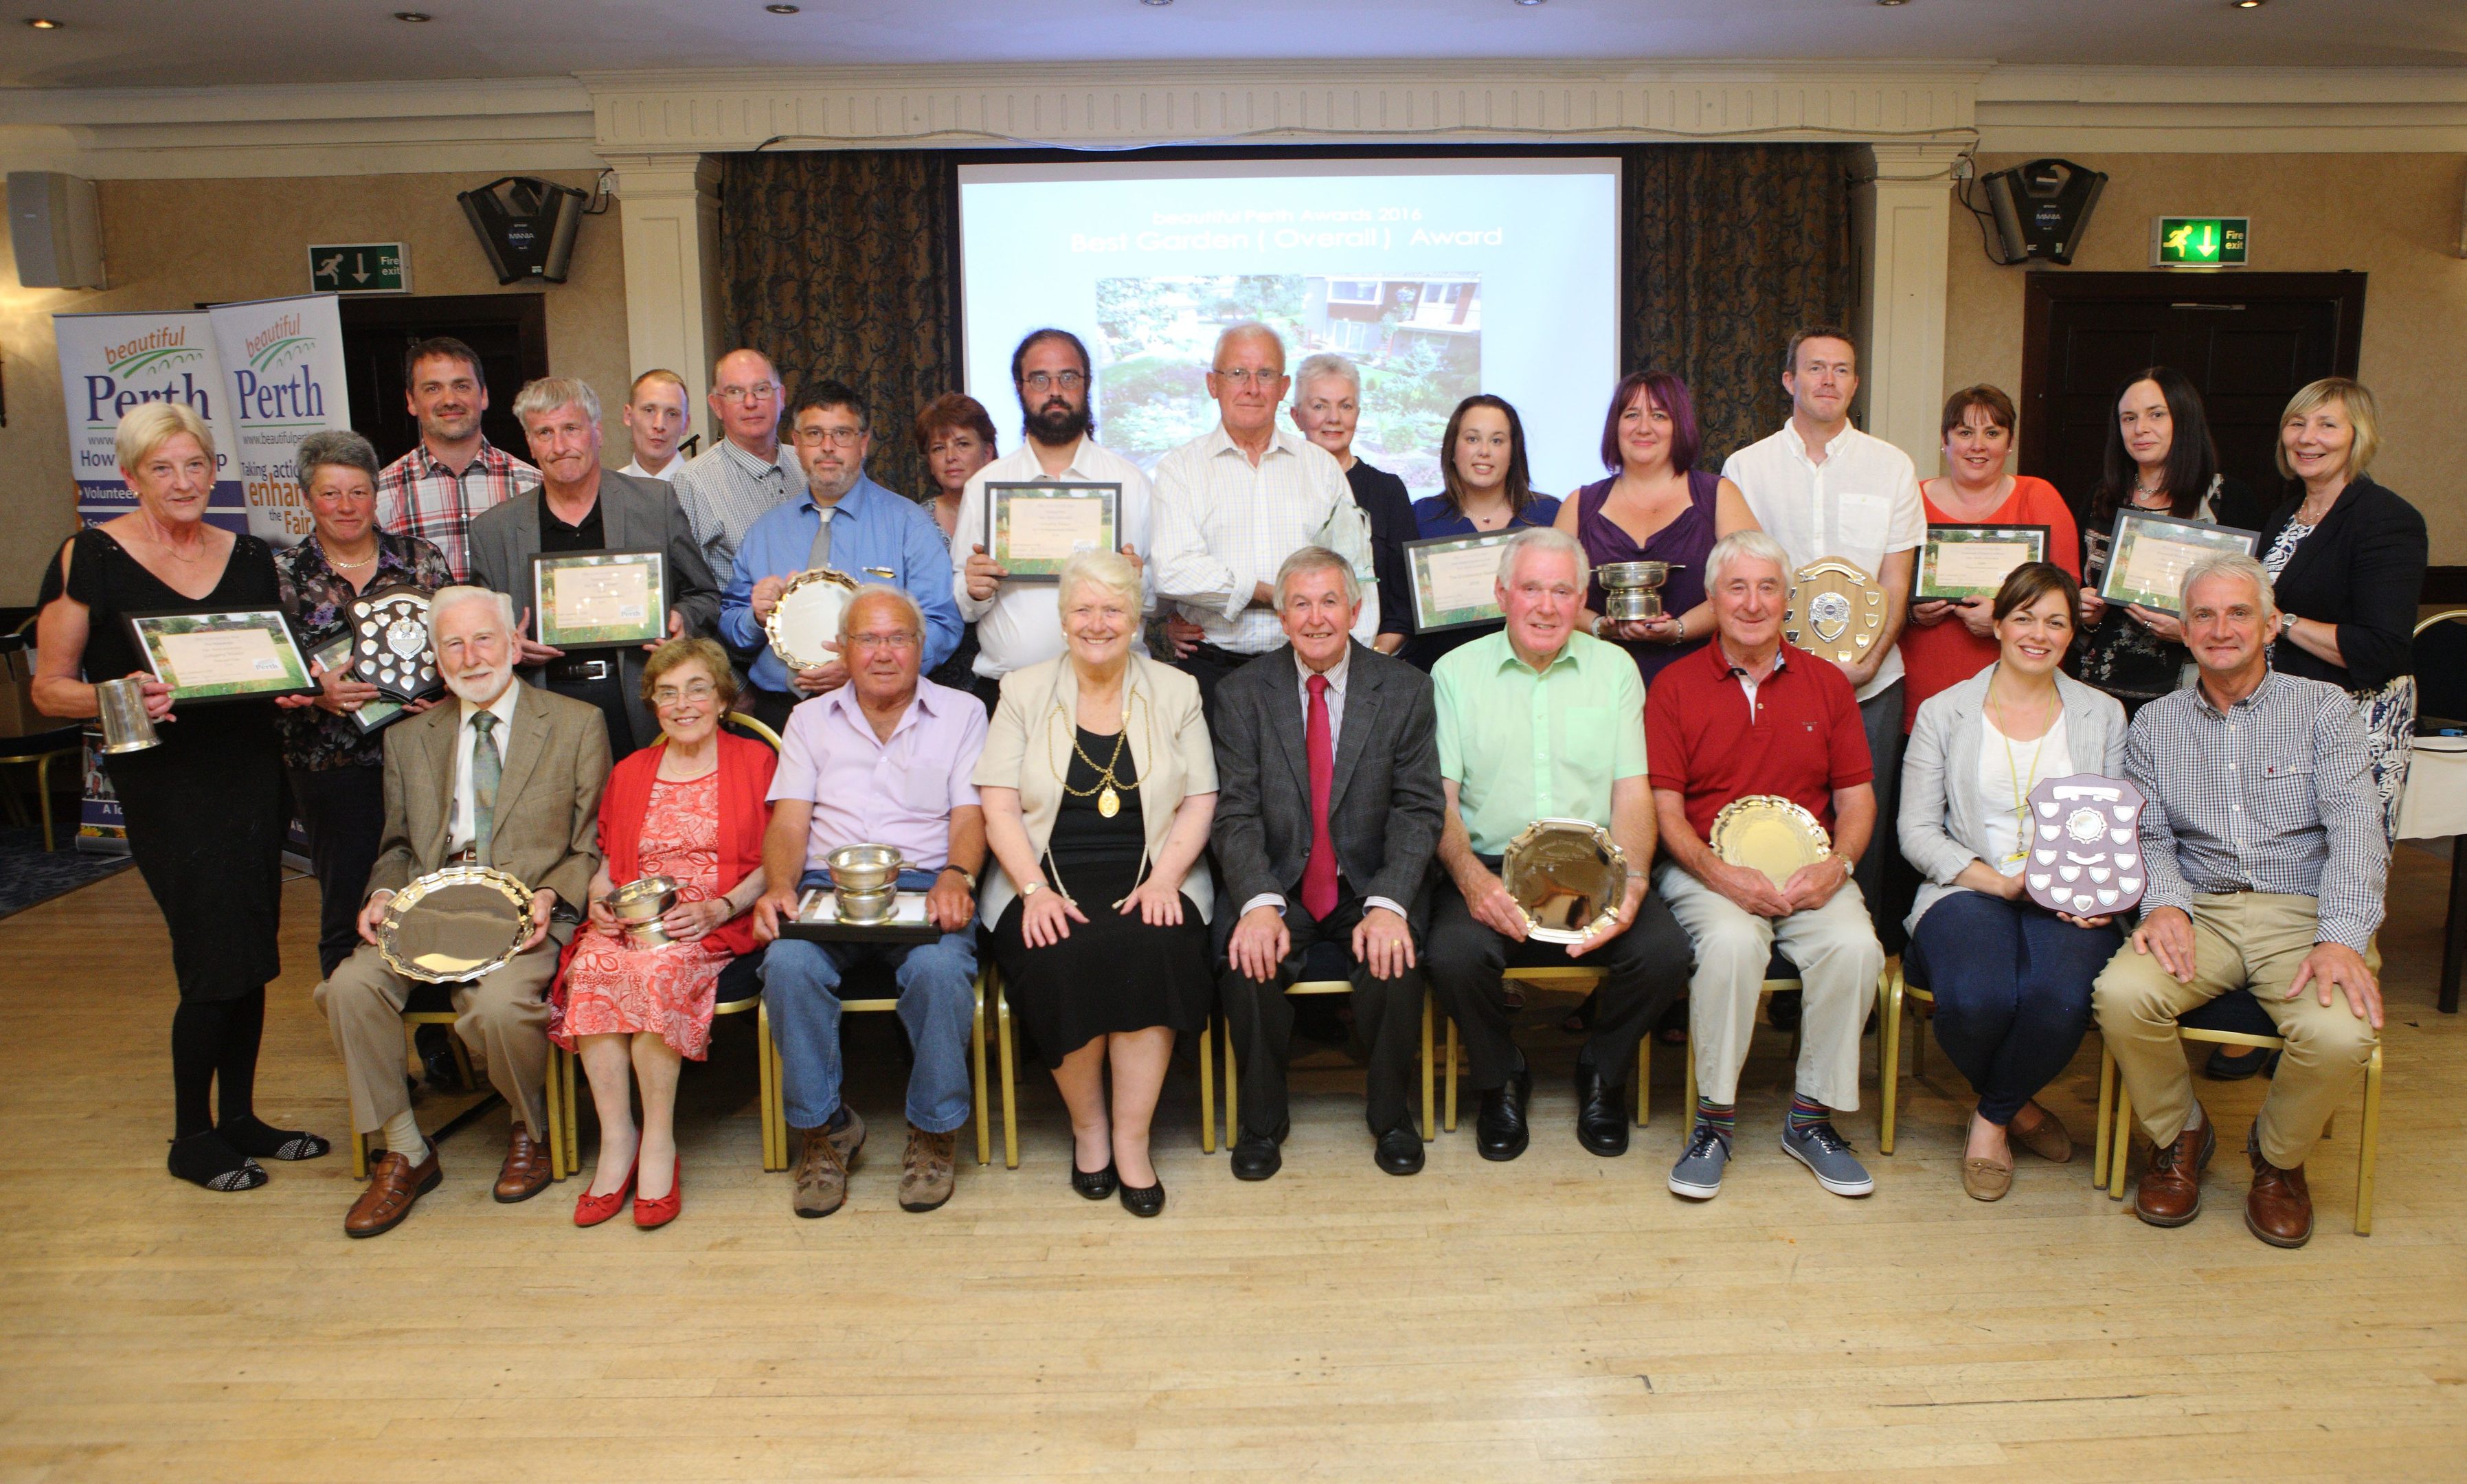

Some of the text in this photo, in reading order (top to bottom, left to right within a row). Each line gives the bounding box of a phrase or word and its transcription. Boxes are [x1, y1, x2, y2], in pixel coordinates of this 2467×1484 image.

[1152, 207, 1423, 225] beautiful Perth Awards 2016
[1070, 232, 1128, 254] Best
[1135, 230, 1249, 251] Garden
[1409, 226, 1503, 247] Award
[2225, 230, 2244, 240] Fire
[2224, 241, 2243, 249] exit
[381, 256, 400, 265] Fire
[381, 267, 401, 276] exit
[245, 313, 300, 359] beautiful
[104, 326, 185, 365] beautiful
[234, 364, 325, 419] Perth
[80, 450, 115, 466] How
[241, 462, 268, 481] Taking
[269, 508, 311, 535] the Fair
